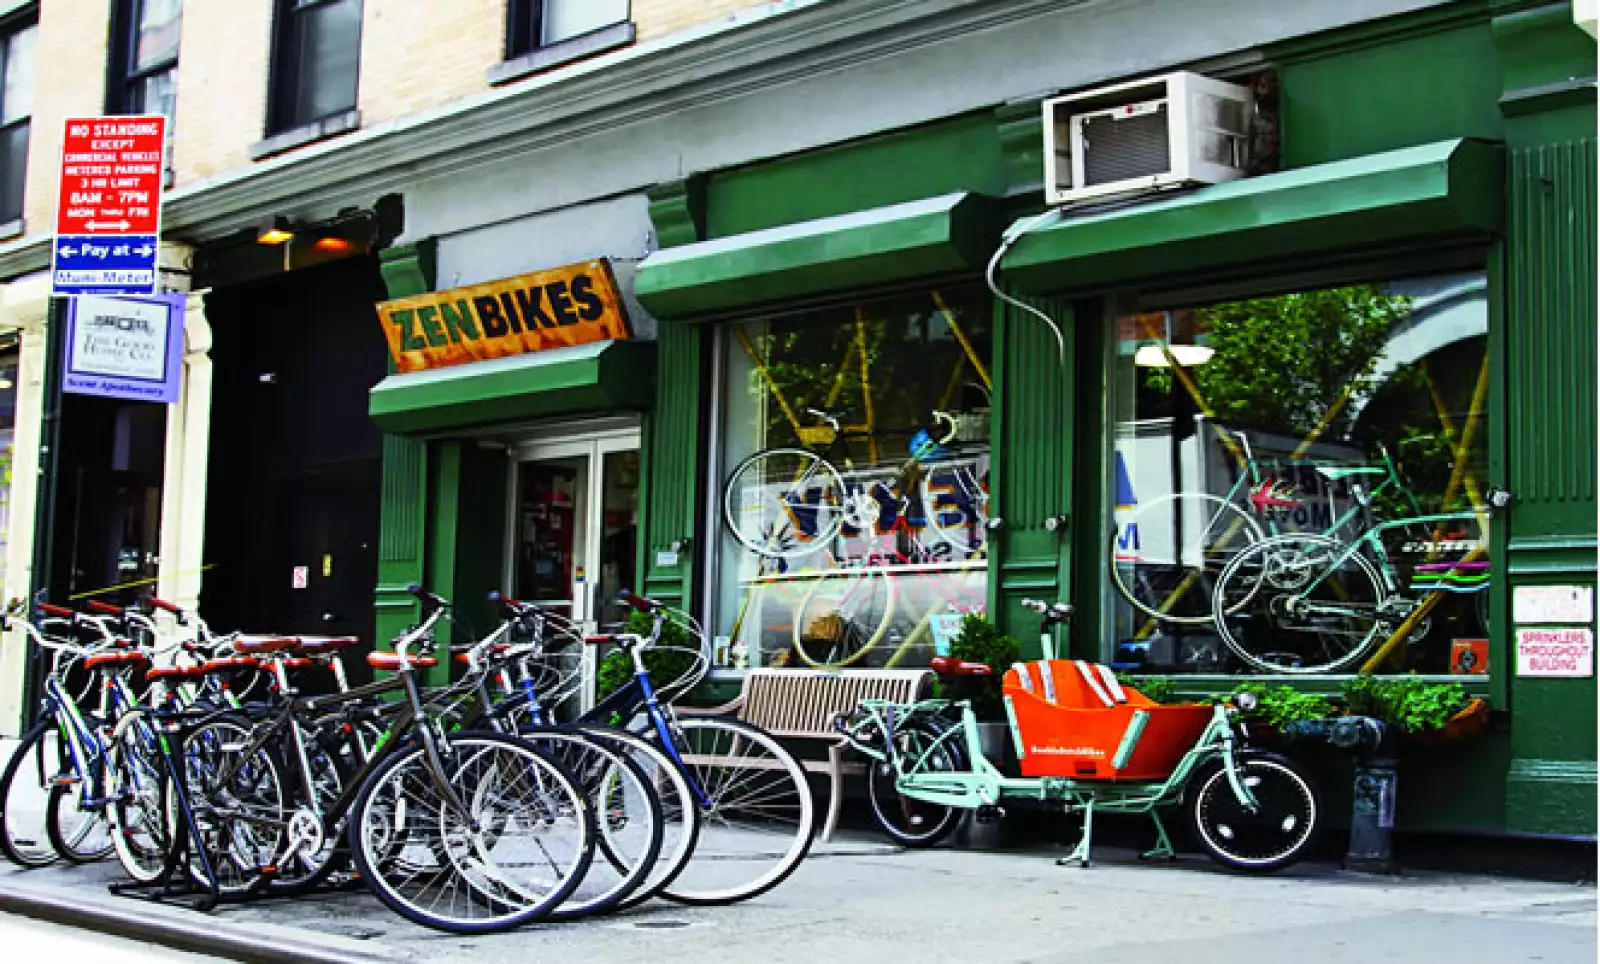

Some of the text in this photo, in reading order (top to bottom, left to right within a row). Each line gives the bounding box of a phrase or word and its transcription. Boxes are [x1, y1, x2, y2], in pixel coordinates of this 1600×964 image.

[70, 123, 159, 136] NO STANDING
[91, 139, 135, 150] EXCEPT
[65, 164, 157, 176] METERED PARKING
[110, 178, 140, 188] LIMIT
[120, 191, 148, 203] 7PM
[67, 208, 95, 217] MON
[128, 207, 149, 217] FRI
[81, 243, 130, 260] Pay at
[1522, 631, 1585, 644] SPRINKLERS
[1520, 645, 1589, 658] THROUGHOUT
[1529, 658, 1577, 671] BUILDING
